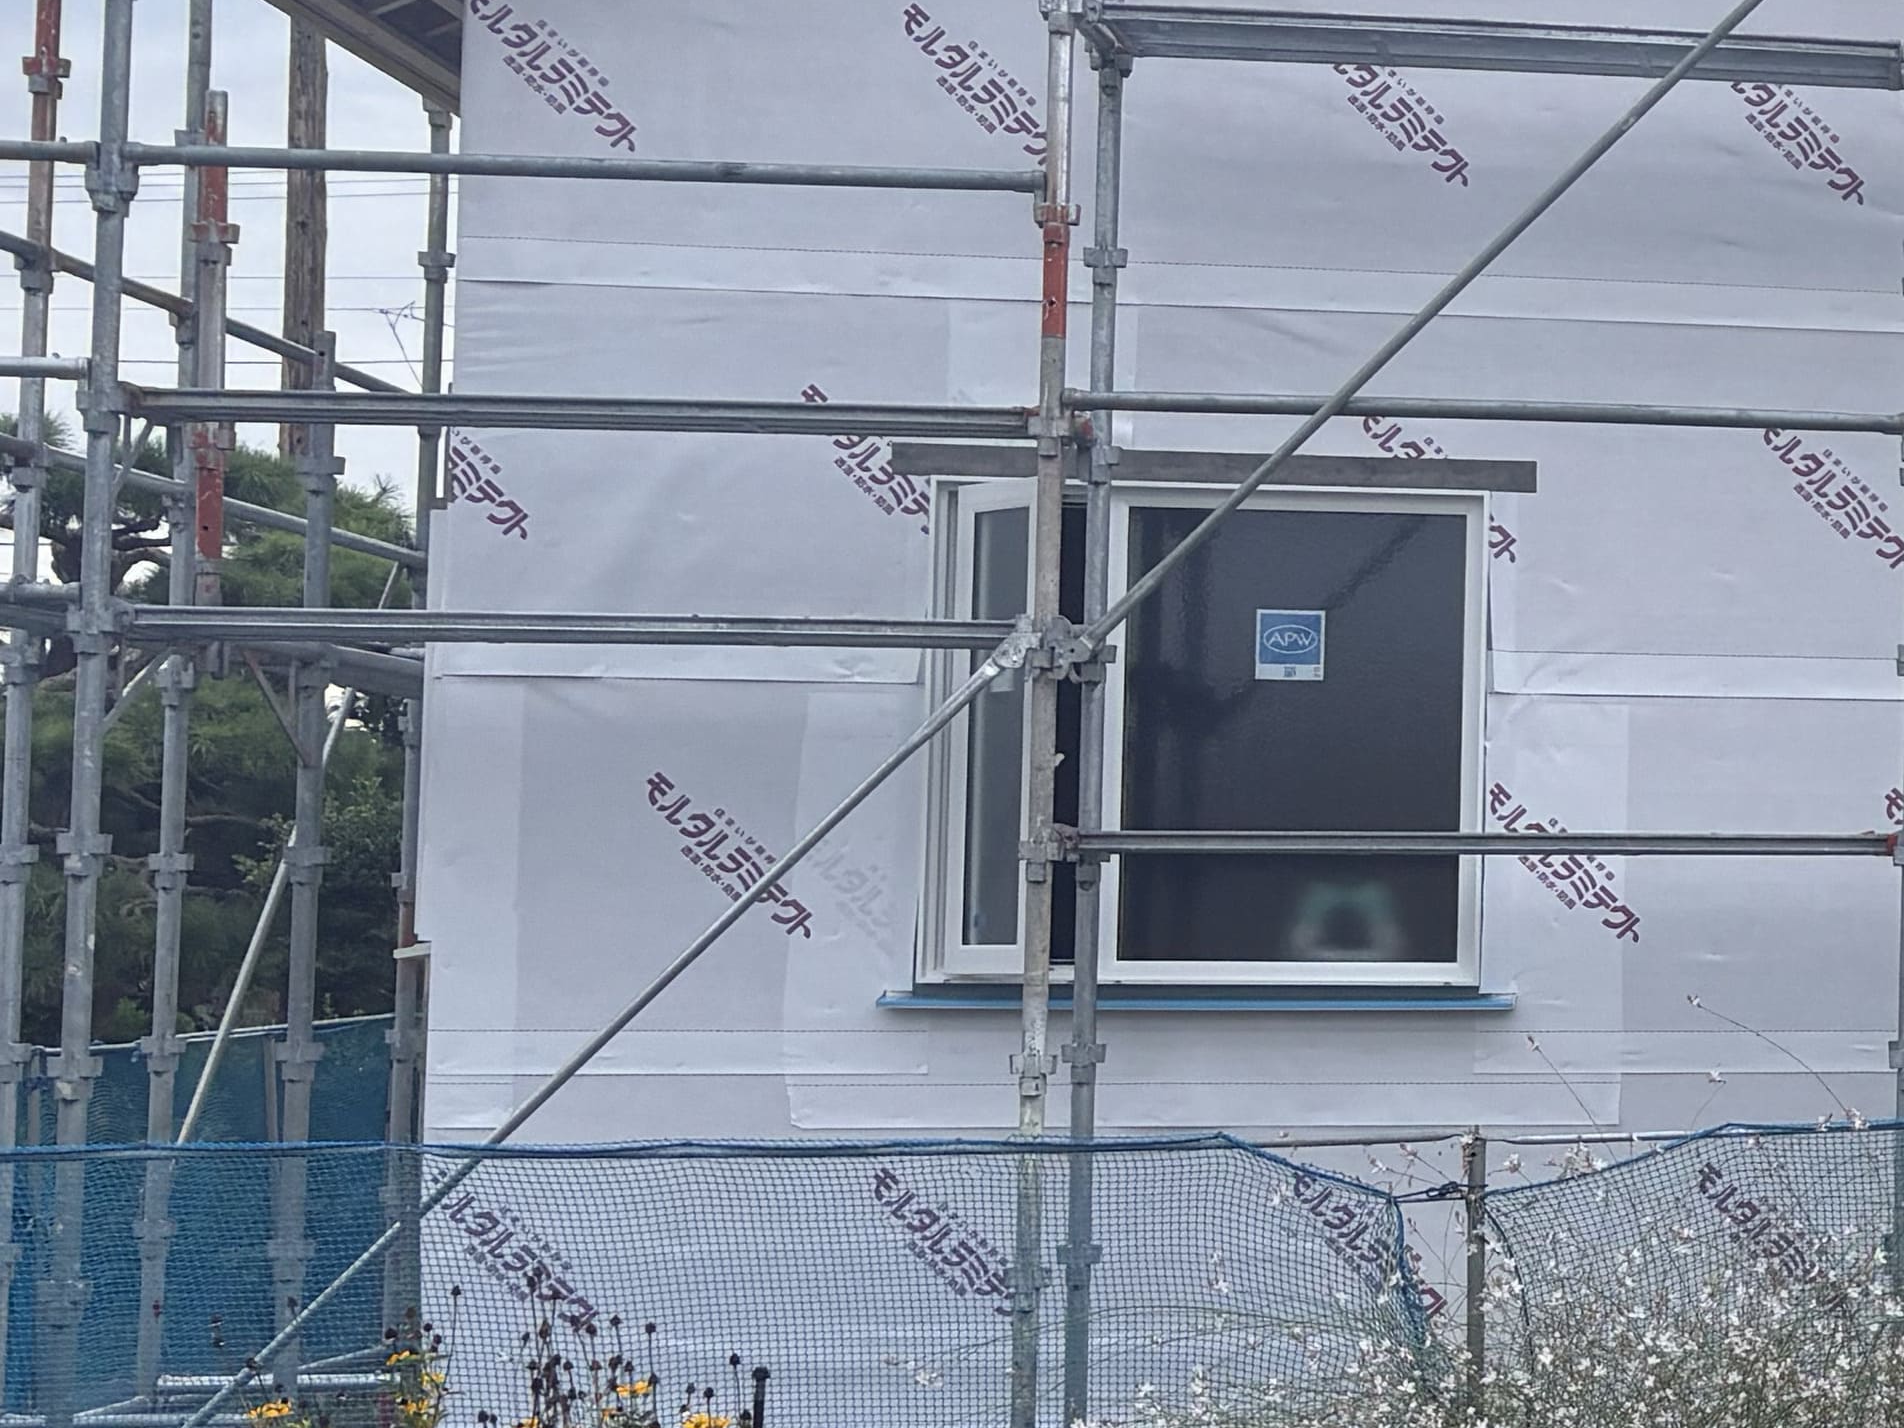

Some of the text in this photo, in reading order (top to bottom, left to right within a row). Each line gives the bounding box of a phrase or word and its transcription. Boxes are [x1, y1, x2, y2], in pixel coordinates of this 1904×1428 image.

[903, 2, 1047, 165] モルタルラミテク
